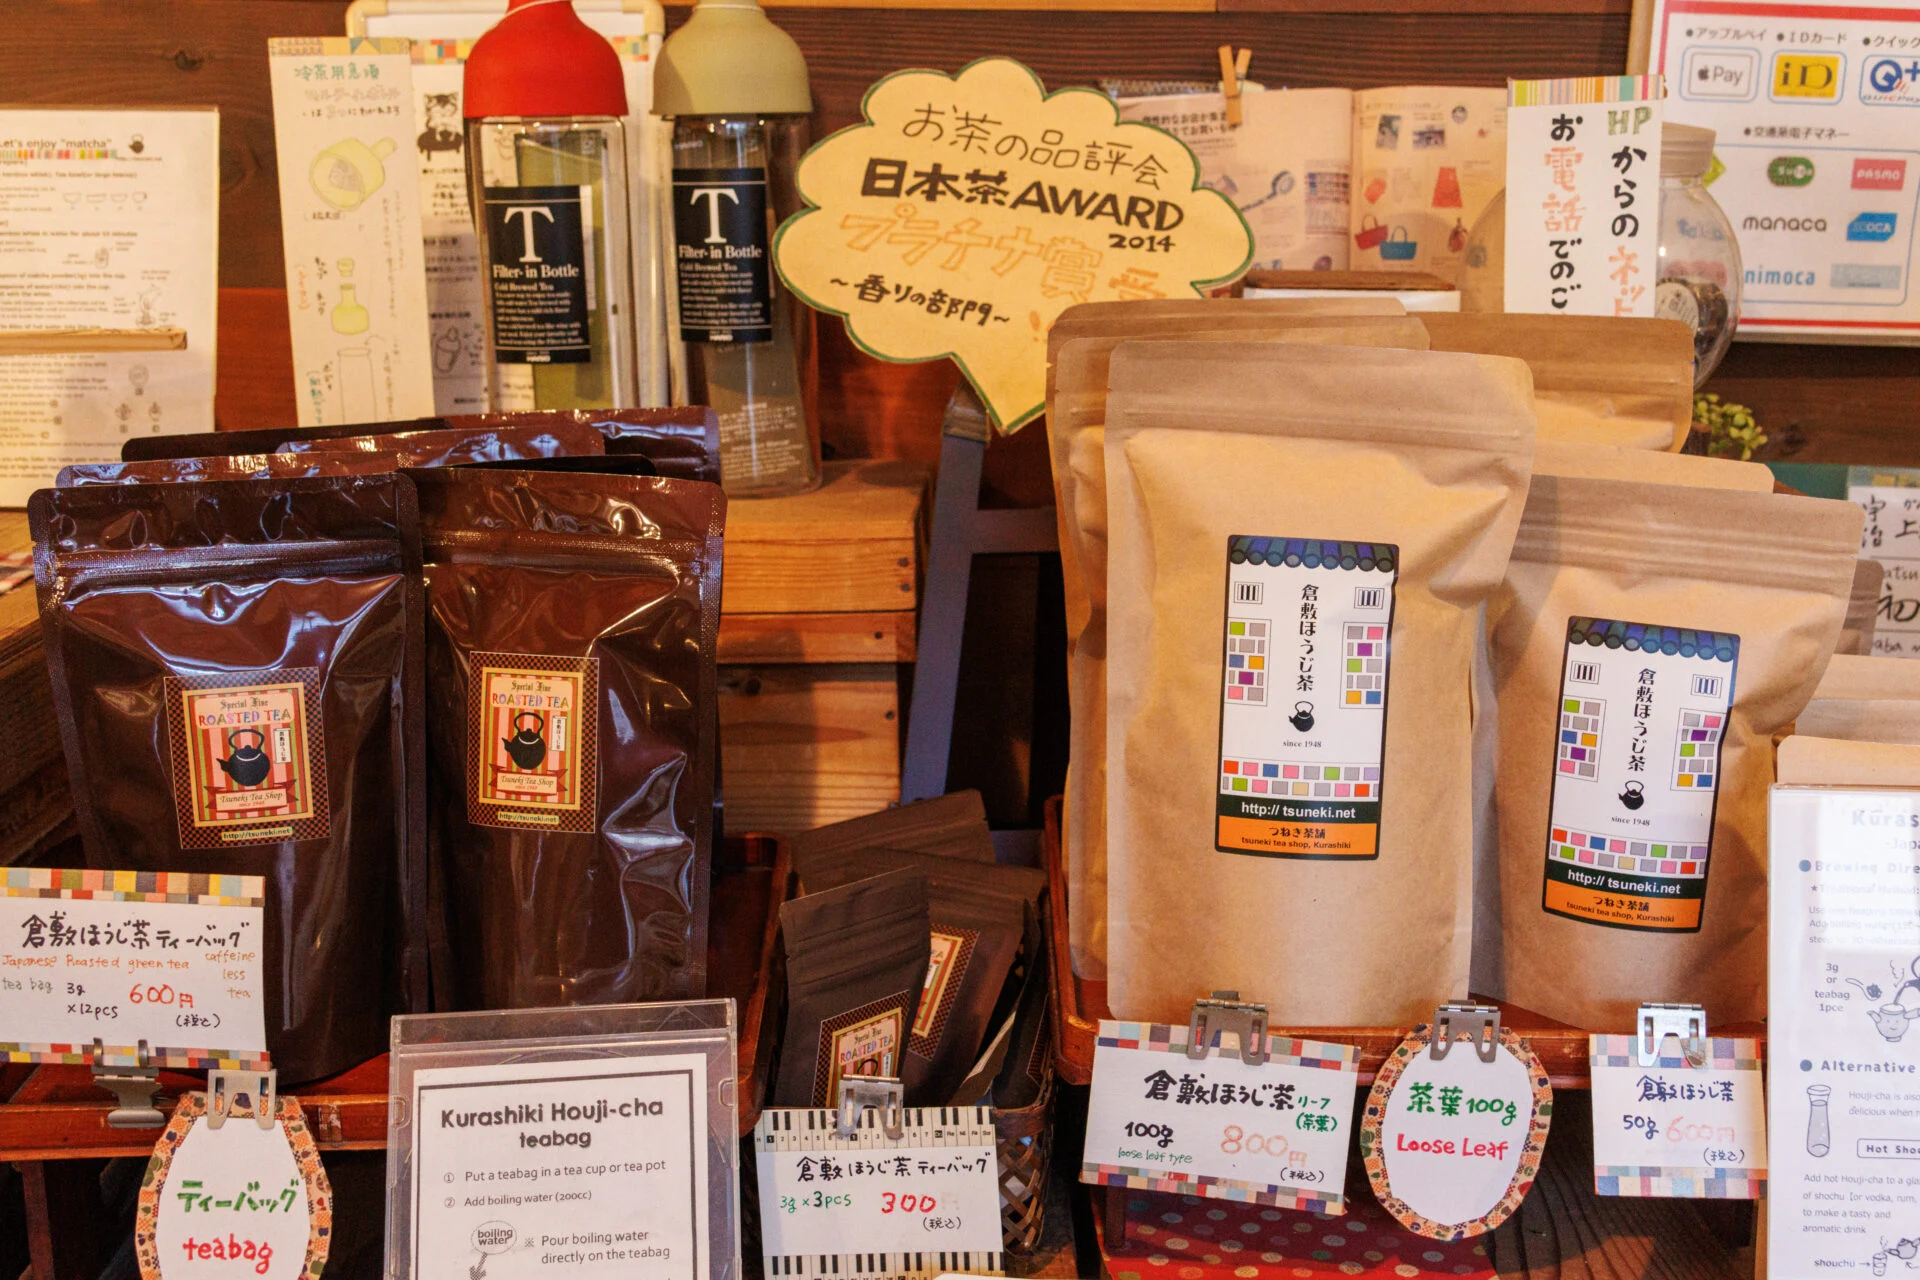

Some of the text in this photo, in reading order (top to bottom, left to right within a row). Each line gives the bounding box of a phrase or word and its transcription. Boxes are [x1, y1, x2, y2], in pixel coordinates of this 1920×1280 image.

[1712, 66, 1743, 86] Pay
[27, 138, 57, 152] enjoy
[902, 102, 1168, 190] お茶の品評会
[1857, 169, 1900, 181] PASMO
[690, 187, 740, 243] T
[1742, 216, 1828, 232] manaca
[504, 206, 555, 263] T
[725, 244, 763, 259] Bottle
[1108, 233, 1176, 254] 2014
[541, 263, 580, 279] Bottle
[1744, 266, 1816, 286] nimoca
[1297, 583, 1320, 692] 倉敷ほうじ茶
[492, 693, 569, 708] ROASTED TEA
[198, 708, 291, 727] ROASTED TEA
[1627, 667, 1657, 772] 倉敷ほうじ茶
[1283, 739, 1322, 748] since 1948
[1241, 802, 1355, 818] http:// tsuneki.net
[1611, 815, 1651, 827] since 1948
[1242, 837, 1271, 845] tsuneki
[1568, 869, 1681, 894] http:// tsuneki.net
[1566, 901, 1594, 913] tsuneki
[1612, 911, 1634, 920] shop,
[1637, 914, 1674, 922] Kurashiki
[2, 954, 189, 974] Japanese Roasted green tea
[205, 950, 255, 963] caffeine
[222, 969, 245, 980] less
[1825, 962, 1839, 974] 3g
[2, 977, 22, 990] tea
[30, 977, 53, 993] bag
[1825, 975, 1838, 984] or
[130, 983, 194, 1008] 600円
[227, 987, 251, 998] tea
[1814, 989, 1851, 1001] teabag
[1819, 1003, 1844, 1014] 1pce
[840, 1034, 894, 1063] ROASTED TEA
[1821, 1060, 1916, 1073] Alternative
[1143, 1070, 1295, 1110] 倉敷ほうじ茶
[1636, 1075, 1735, 1102] 倉敷ほうじ茶
[1849, 1091, 1890, 1101] Houji-cha
[1298, 1096, 1331, 1109] リーフ
[1406, 1081, 1517, 1126] 茶葉100g
[441, 1098, 663, 1129] Kurashiki Houji-cha
[1849, 1106, 1912, 1116] delicious when
[1296, 1113, 1338, 1133] (茶葉)
[1622, 1114, 1659, 1140] 50g
[520, 1130, 592, 1149] teabag
[1124, 1121, 1174, 1148] 100g
[1220, 1125, 1307, 1168] 800円
[1397, 1133, 1508, 1160] Loose Leaf
[1866, 1145, 1888, 1153] Hot
[1118, 1147, 1193, 1166] loose leaf type
[465, 1171, 485, 1182] Put
[498, 1168, 538, 1180] teabag
[541, 1166, 551, 1177] in
[554, 1168, 561, 1176] a
[564, 1165, 582, 1176] tea
[586, 1164, 606, 1176] cup
[609, 1164, 621, 1173] or
[624, 1162, 643, 1171] tea
[646, 1160, 666, 1173] pot
[1804, 1174, 1895, 1185] Add hot Houji-cha to
[177, 1179, 299, 1213] ティーバッグ
[464, 1190, 592, 1207] Add boiling water (200cc)
[1814, 1192, 1844, 1200] shochu
[1815, 1209, 1839, 1217] make
[1849, 1210, 1871, 1219] tasty
[1874, 1210, 1891, 1218] and
[478, 1229, 513, 1239] boiling
[1803, 1225, 1841, 1233] aromatic
[478, 1236, 510, 1246] water
[541, 1230, 649, 1246] Pour boiling water
[182, 1233, 273, 1275] teabag
[541, 1246, 670, 1264] directly on the teabag
[1814, 1259, 1855, 1268] shouchu
